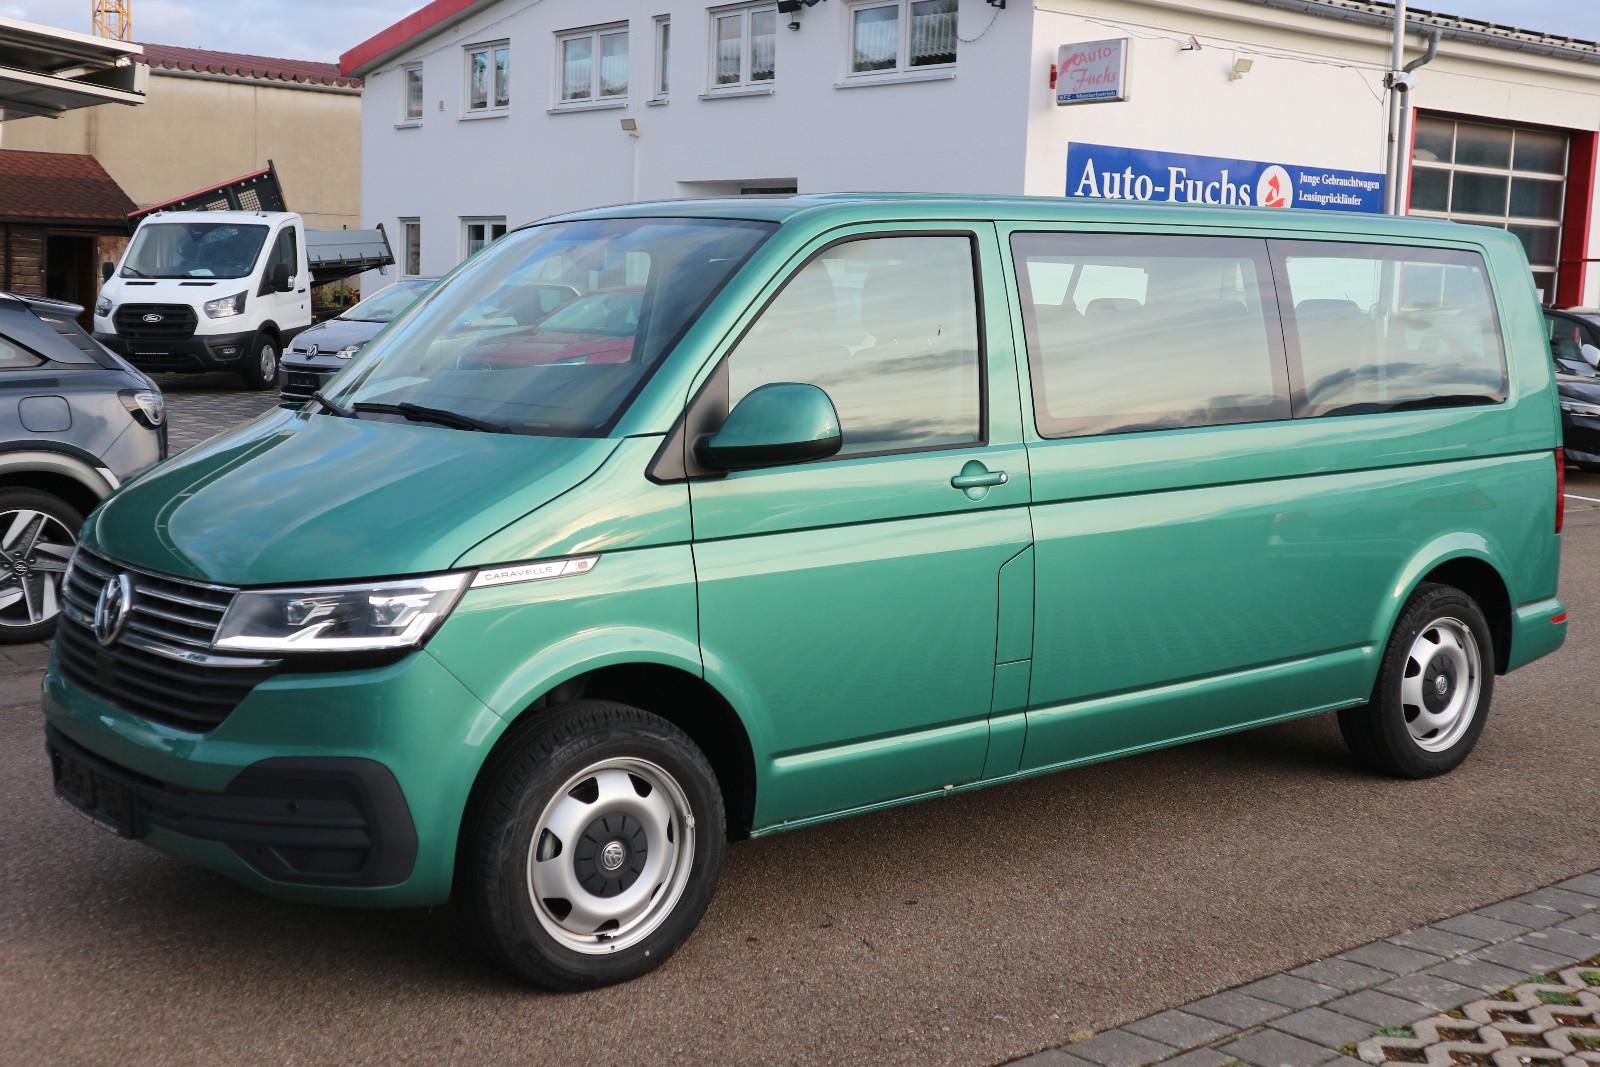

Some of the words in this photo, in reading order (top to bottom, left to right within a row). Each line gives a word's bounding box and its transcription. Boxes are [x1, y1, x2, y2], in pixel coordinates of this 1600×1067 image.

[1070, 65, 1117, 91] Fuchs
[1074, 158, 1251, 206] Auto-Fuchs
[1300, 172, 1321, 186] Junge
[1322, 174, 1380, 191] Gebrauchtwagen
[1299, 190, 1362, 206] Leasingrückläufer
[484, 566, 553, 580] CARAVELLE
